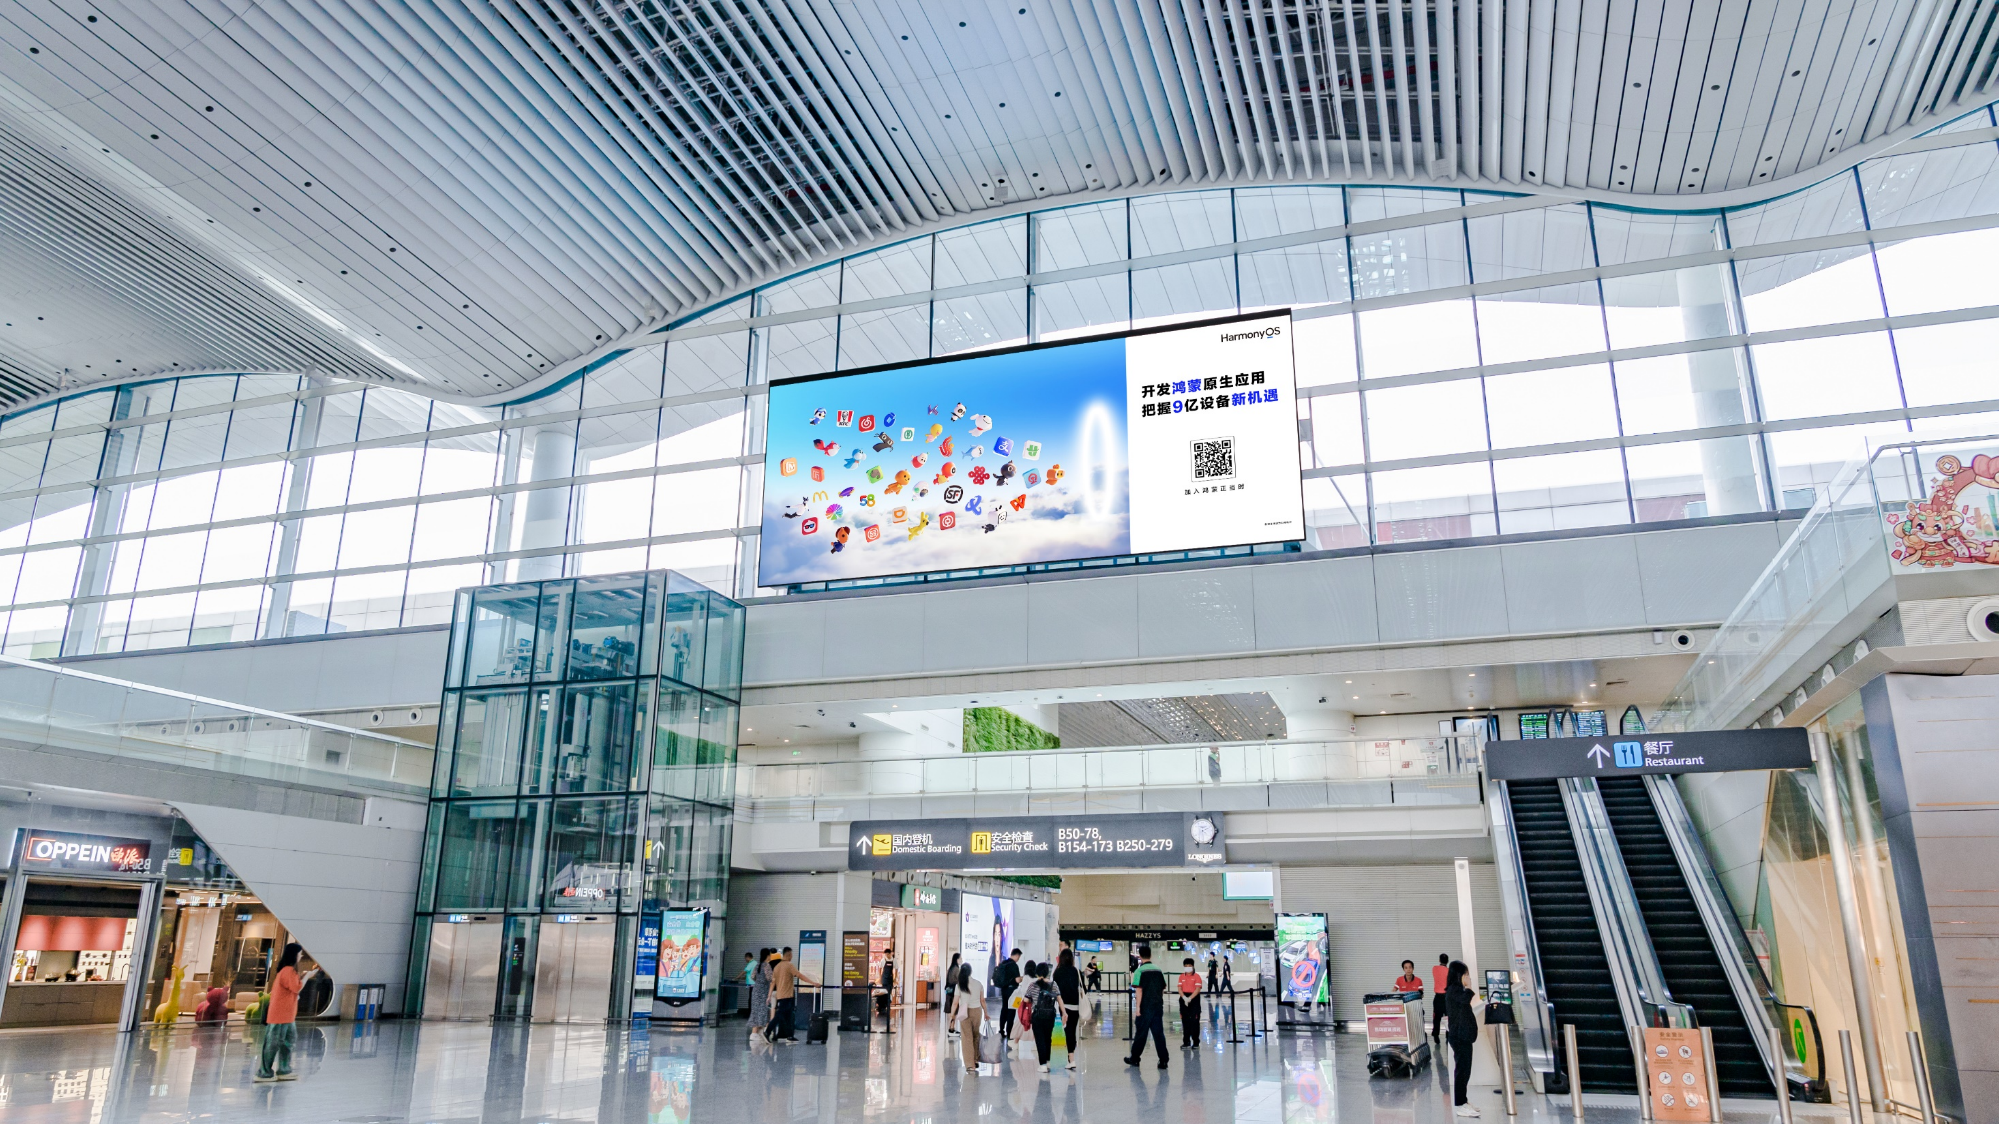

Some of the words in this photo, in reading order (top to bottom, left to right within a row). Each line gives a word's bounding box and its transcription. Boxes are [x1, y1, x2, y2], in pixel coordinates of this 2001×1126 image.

[1221, 327, 1281, 342] HarmonyOS
[1142, 371, 1265, 398] 开发鸿蒙原生应用
[1142, 388, 1279, 417] 把握9亿设备新机遇
[859, 493, 876, 507] 58
[1643, 740, 1674, 755] 餐厅
[1645, 756, 1705, 767] Restaurant
[892, 833, 933, 846] 国内登机
[991, 831, 1034, 843] 安全检查
[1058, 828, 1102, 840] B50-78,
[36, 841, 112, 863] OPPEIN
[892, 845, 926, 853] Domestic
[927, 844, 962, 854] Boarding
[991, 843, 1022, 853] Security
[1024, 842, 1048, 851] Check
[1058, 841, 1113, 853] B154-173
[1116, 839, 1173, 851] B250-279
[1187, 853, 1222, 861] LONGINES
